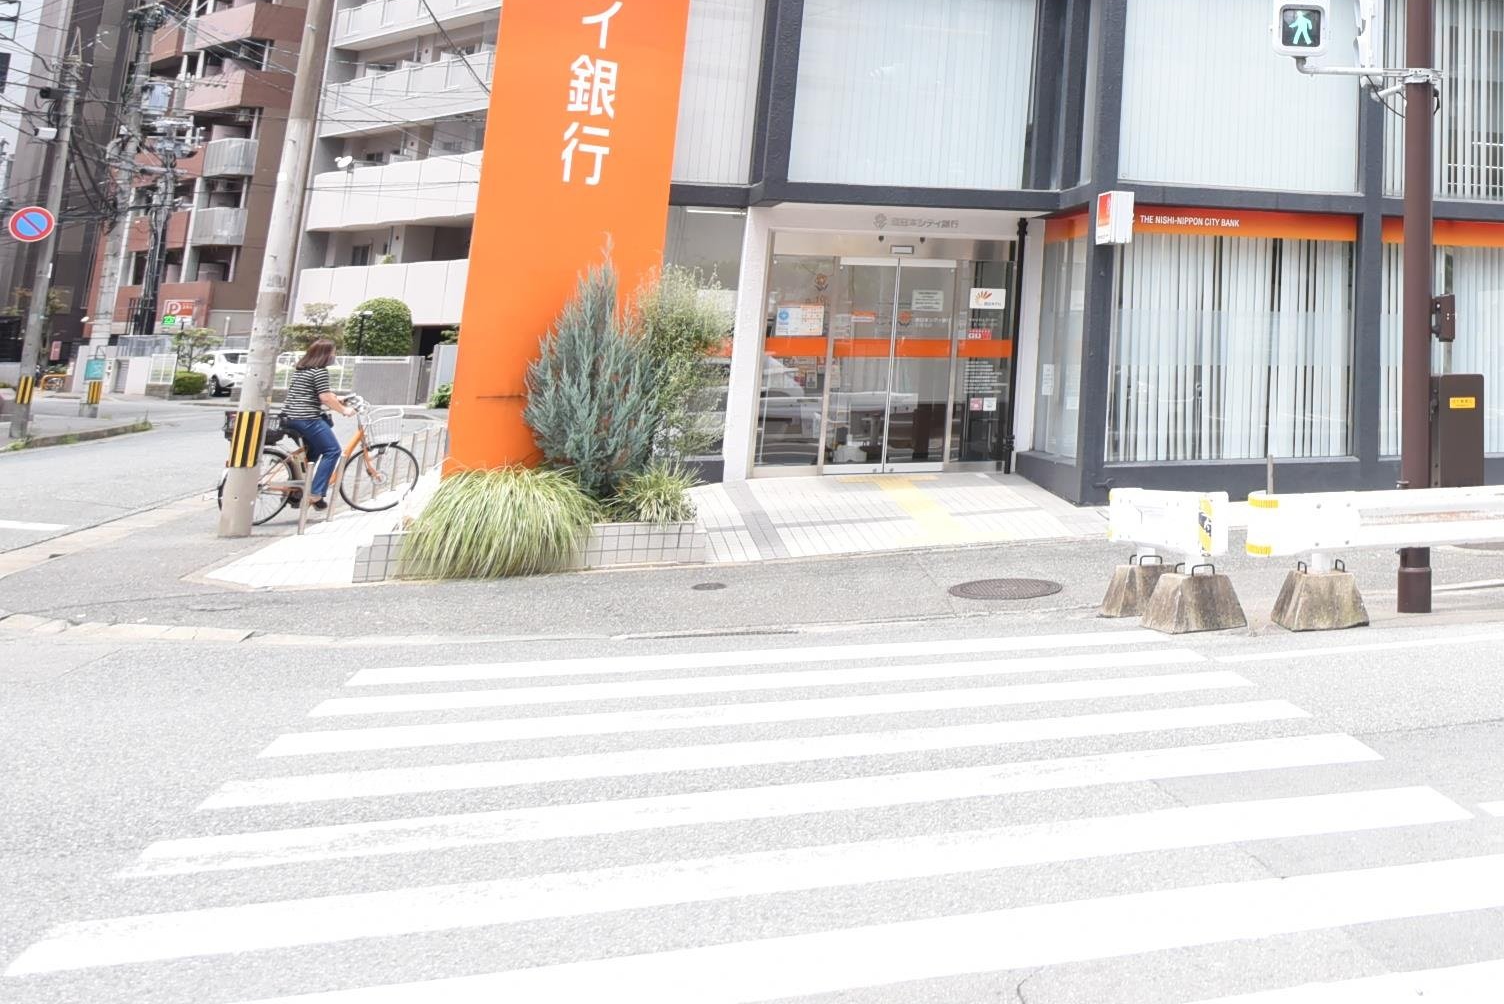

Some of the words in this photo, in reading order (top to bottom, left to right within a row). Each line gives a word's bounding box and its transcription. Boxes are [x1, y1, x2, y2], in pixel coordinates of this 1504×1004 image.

[890, 217, 960, 229] 西日本シティ銀行
[1139, 214, 1153, 224] THE
[1155, 215, 1203, 226] NISHI-NIPPON
[1204, 217, 1220, 227] CITY
[1220, 218, 1240, 227] BANK
